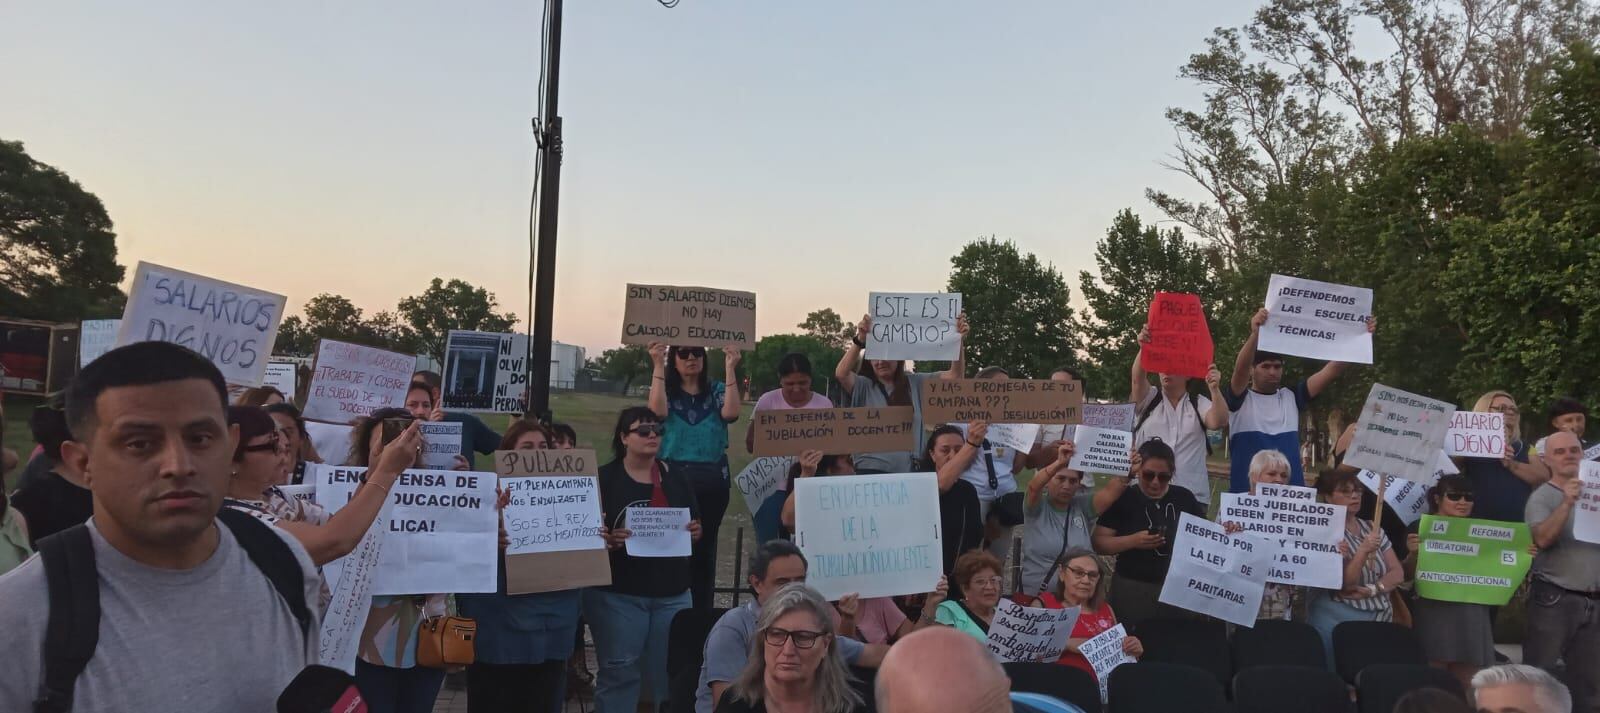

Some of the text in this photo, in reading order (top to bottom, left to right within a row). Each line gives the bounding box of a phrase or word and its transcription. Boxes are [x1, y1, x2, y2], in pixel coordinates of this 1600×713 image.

[629, 287, 756, 311] SIN SALARIOS DIGNOS
[1278, 287, 1356, 305] ¡DEFENDEMOS
[682, 306, 722, 322] NO HAY
[875, 296, 960, 319] ESTE ES EL
[1281, 304, 1372, 323] LAS ESCUELAS
[626, 323, 746, 342] CALIDAD EDUCATIVA
[872, 320, 950, 347] CAMBIO?
[1278, 324, 1336, 340] TÉCNICAS!
[147, 319, 256, 369] DIGNOS
[501, 337, 512, 355] NI
[500, 357, 524, 372] OLVI
[374, 375, 405, 390] COBRE
[511, 373, 526, 384] DO
[315, 385, 325, 397] EL
[363, 391, 375, 401] DE
[496, 382, 508, 397] NI
[930, 382, 1075, 393] Y LAS PROMESAS DE TU
[928, 395, 981, 408] CAMPAÑA
[761, 410, 880, 425] EN DEFENSA DE LA
[766, 424, 834, 441] JUBILACIÓN
[1090, 447, 1128, 457] EDUCATIVA
[1096, 441, 1126, 449] CALIDAD
[503, 450, 585, 474] PULLARO
[1099, 456, 1131, 464] SALARIOS
[455, 476, 478, 489] DE
[508, 478, 594, 491] EN PLENA CAMPAÑA
[1261, 487, 1312, 499] EN 2024
[1237, 497, 1335, 516] LOS JUBILADOS
[546, 516, 562, 528] EL
[566, 513, 589, 524] REY
[1227, 507, 1329, 526] DEBEN PERCIBIR
[390, 519, 436, 533] LICA!
[1287, 526, 1304, 537] EN
[1433, 522, 1512, 538] LA REFORMA
[512, 537, 529, 549] DE
[1185, 522, 1253, 552] RESPETO POR
[1279, 539, 1287, 548] Y
[1280, 554, 1289, 562] A
[1292, 555, 1307, 565] 60
[1426, 541, 1514, 563] JUBILATORIA ES
[1190, 547, 1252, 576] LA LEY DE
[1420, 572, 1509, 586] ANTICONSTITUCIONAL
[1187, 578, 1246, 605] PARITARIAS.
[997, 617, 1038, 636] escala
